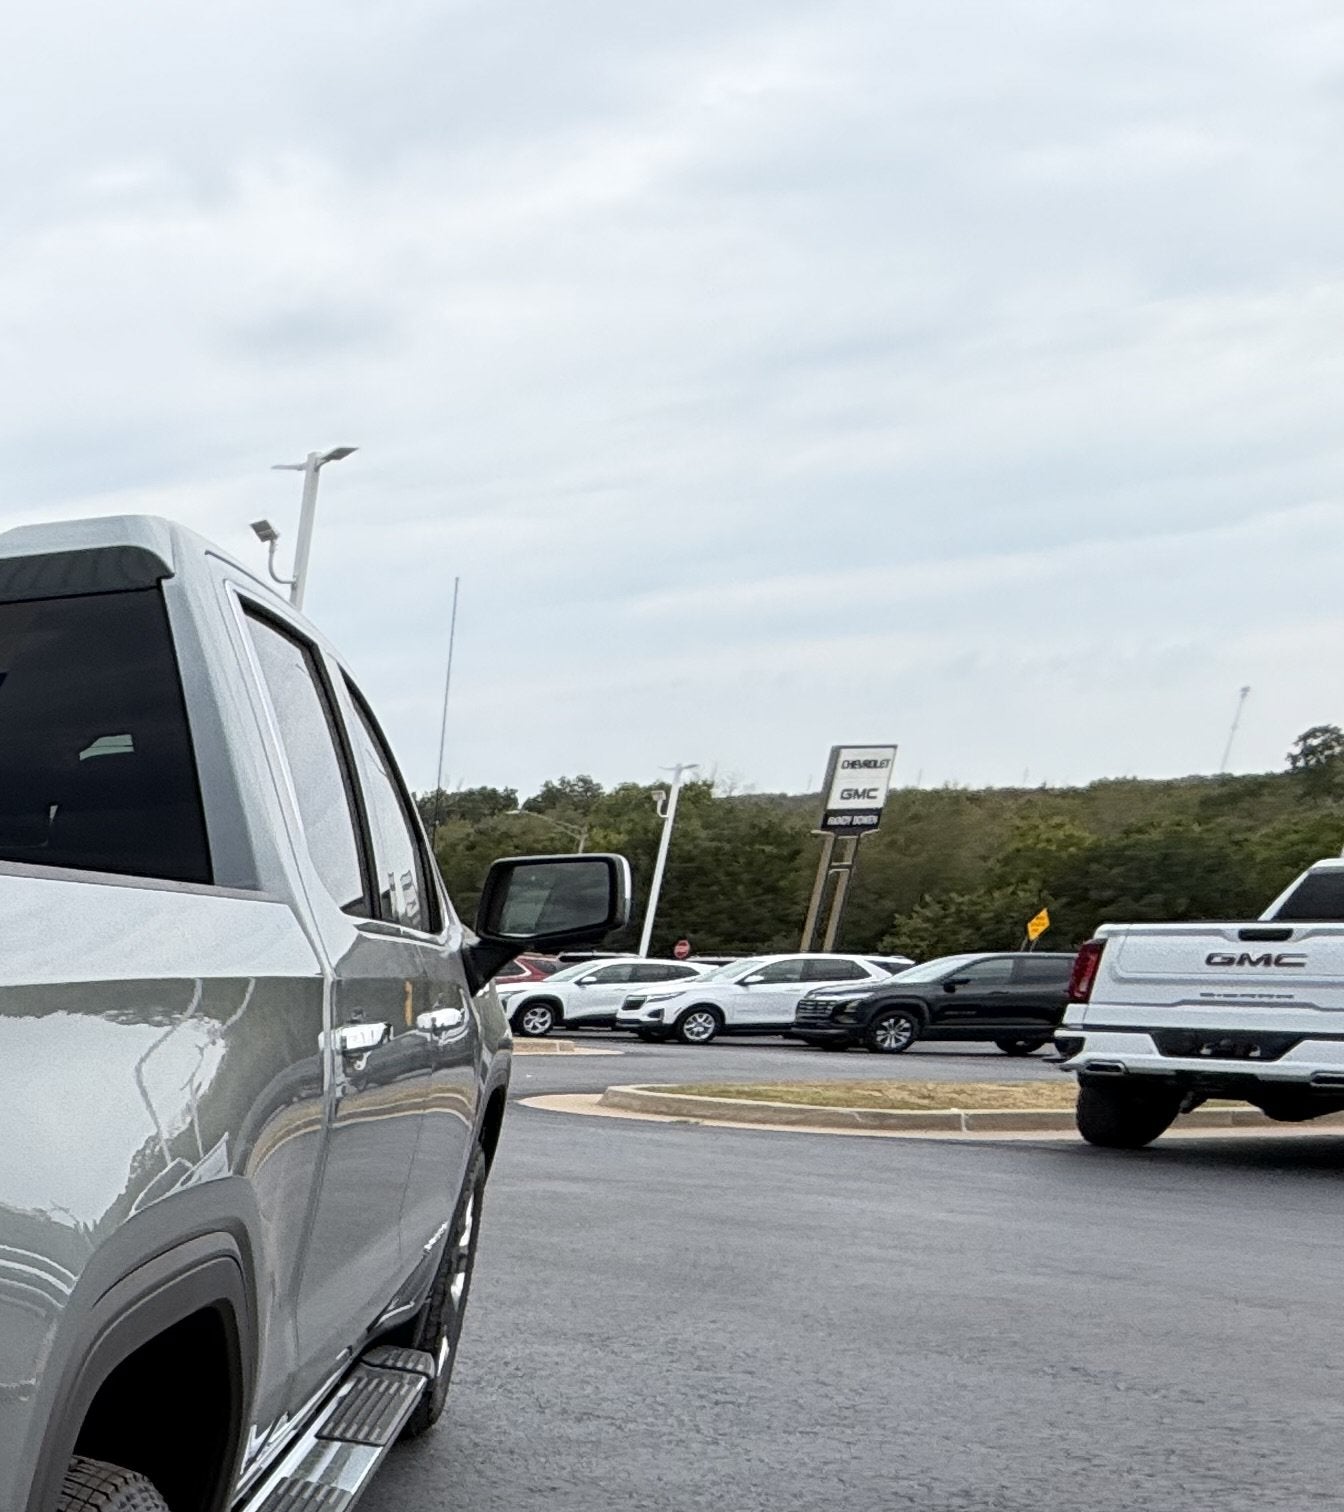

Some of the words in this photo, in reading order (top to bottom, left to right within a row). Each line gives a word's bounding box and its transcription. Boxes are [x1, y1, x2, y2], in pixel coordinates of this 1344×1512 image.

[841, 758, 891, 769] CHEVROLET
[840, 788, 879, 800] GMC
[1205, 952, 1308, 967] GMC
